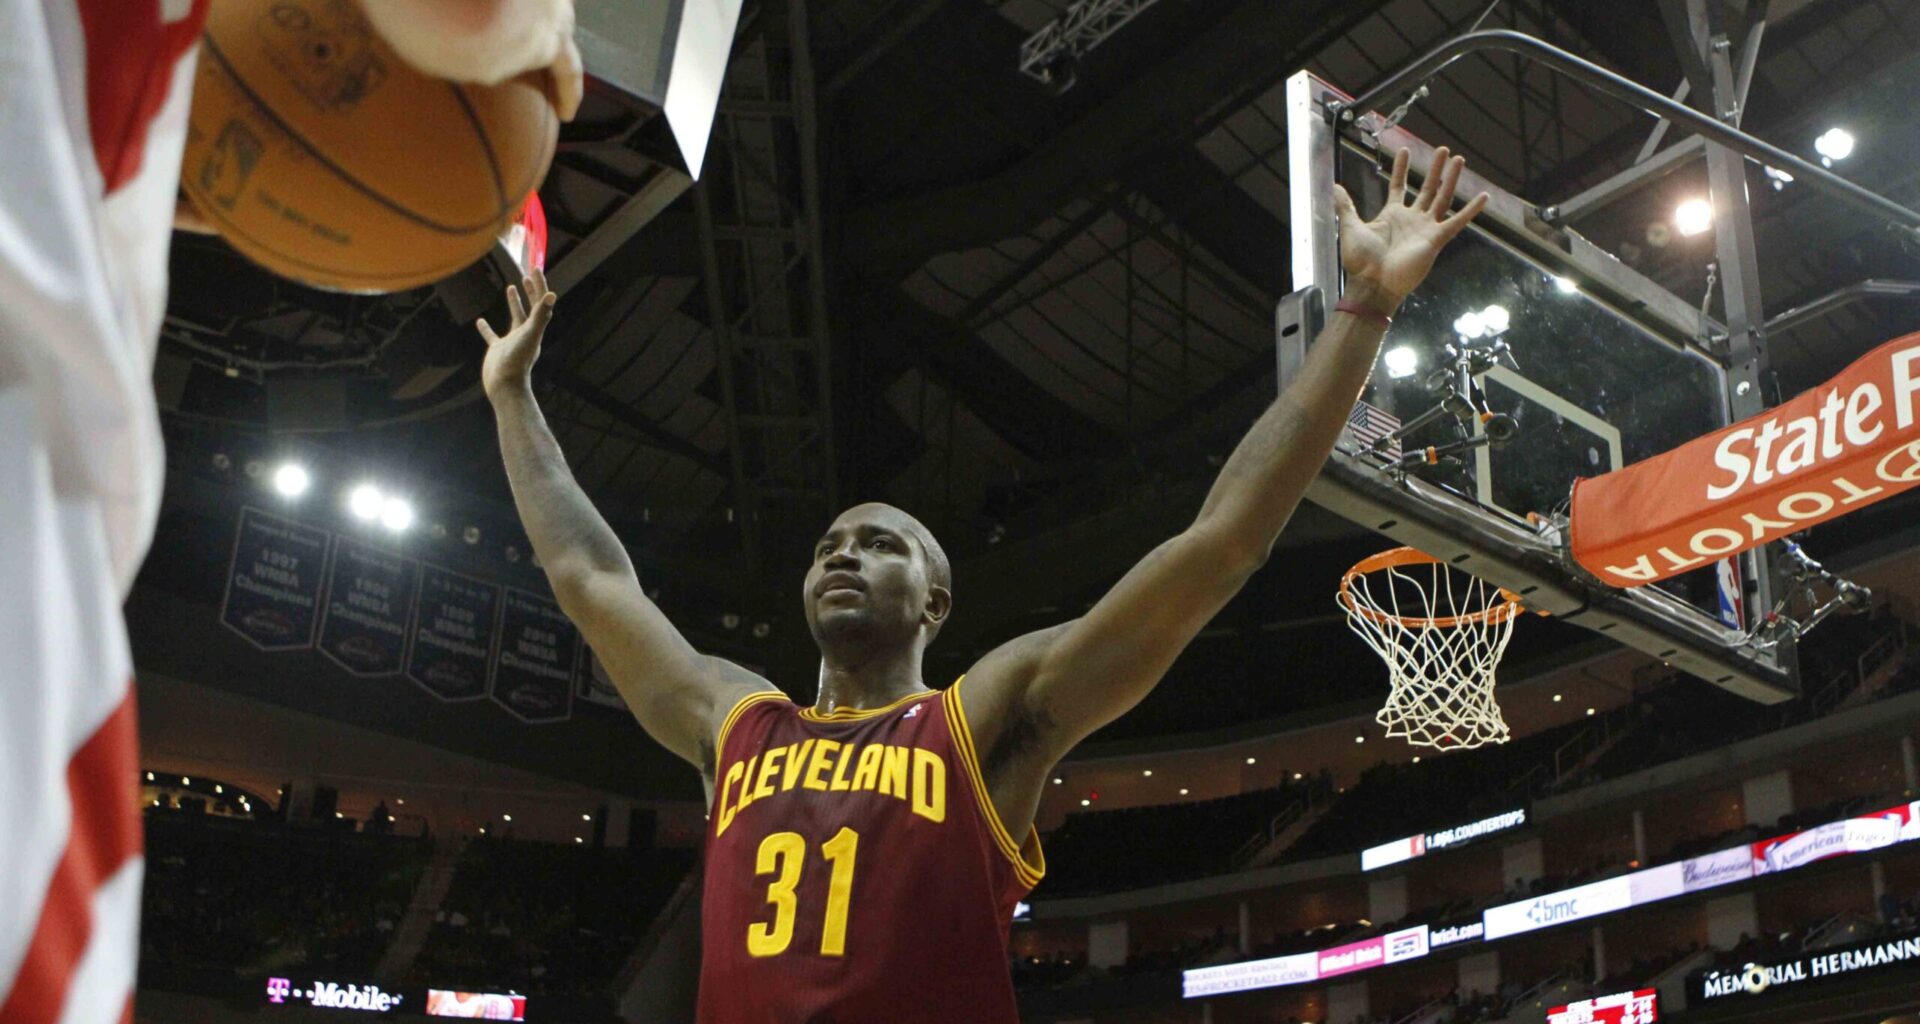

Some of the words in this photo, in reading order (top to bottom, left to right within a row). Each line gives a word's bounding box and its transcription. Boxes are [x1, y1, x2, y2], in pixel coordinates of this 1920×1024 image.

[1707, 384, 1884, 500] State
[1604, 477, 1883, 580] TOYOTA
[235, 574, 313, 607] Champions
[254, 562, 299, 588] WNBA
[331, 602, 403, 635] Champions
[348, 591, 390, 616] WNBA
[501, 651, 570, 680] Champions
[716, 739, 946, 838] CLEVELAND
[1683, 856, 1751, 884] Budweiser
[747, 826, 859, 957] 31
[1543, 899, 1578, 922] bmc
[1704, 961, 1807, 998] MEMORIAL
[1811, 936, 1920, 977] HERMANN
